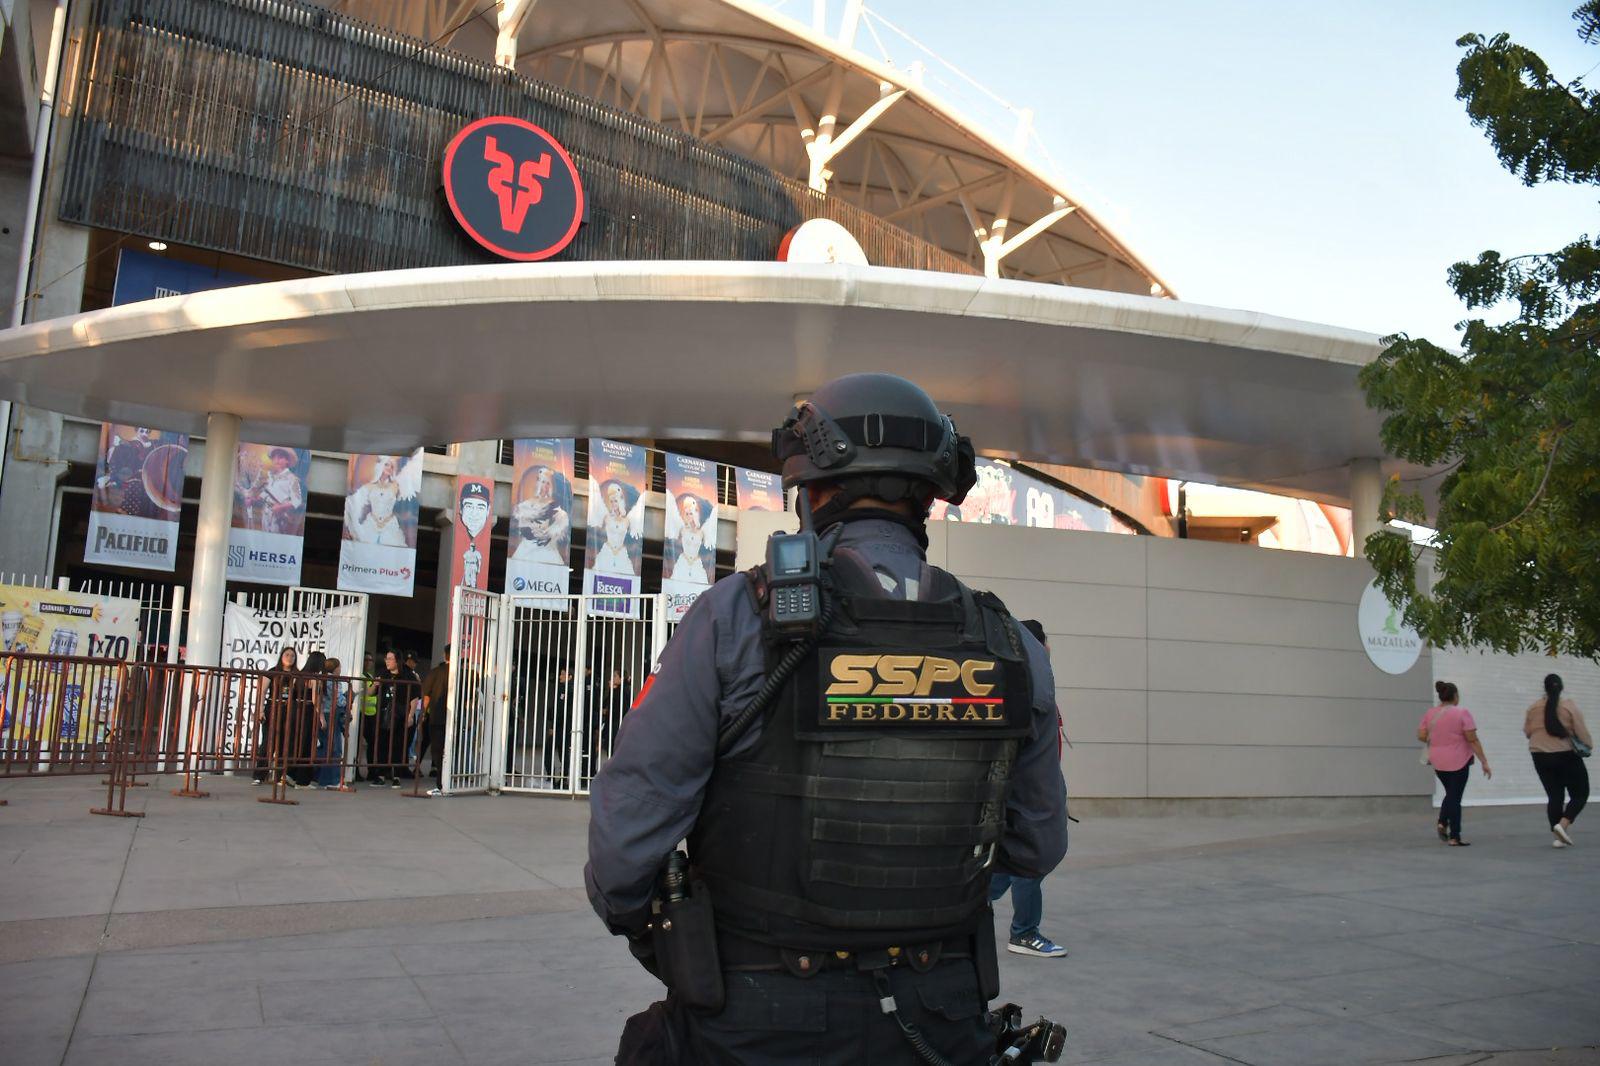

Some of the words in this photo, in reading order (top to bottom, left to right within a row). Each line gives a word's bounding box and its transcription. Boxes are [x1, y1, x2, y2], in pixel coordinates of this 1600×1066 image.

[95, 526, 169, 555] PACIFICO
[249, 550, 296, 565] HERSA
[342, 563, 378, 575] Primera
[379, 567, 399, 577] Plus
[526, 580, 562, 594] MEGA
[257, 620, 324, 639] ZONAS
[825, 654, 995, 697] SSPC
[827, 703, 1003, 721] FEDERAL
